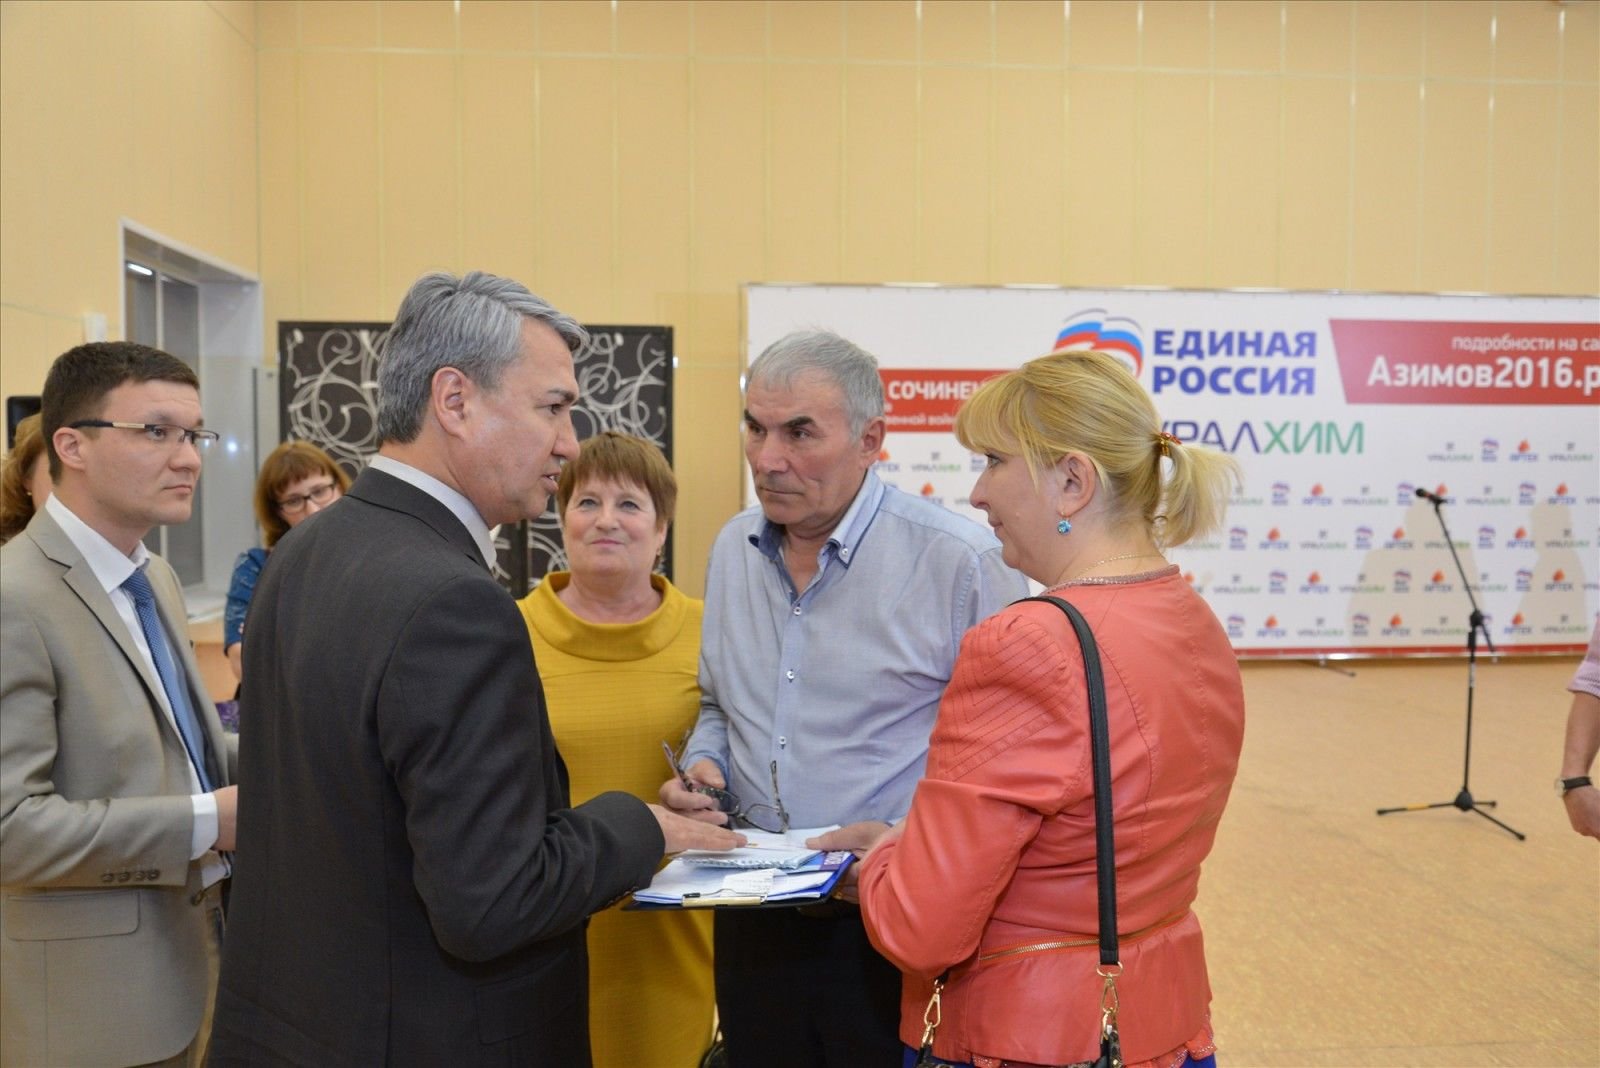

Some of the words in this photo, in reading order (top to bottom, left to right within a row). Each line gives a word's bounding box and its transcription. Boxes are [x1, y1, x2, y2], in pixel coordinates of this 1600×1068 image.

[1153, 329, 1317, 360] ЕДИНАЯ
[1452, 333, 1555, 352] подробности
[1558, 337, 1578, 351] на
[1153, 366, 1316, 396] РОССИЯ
